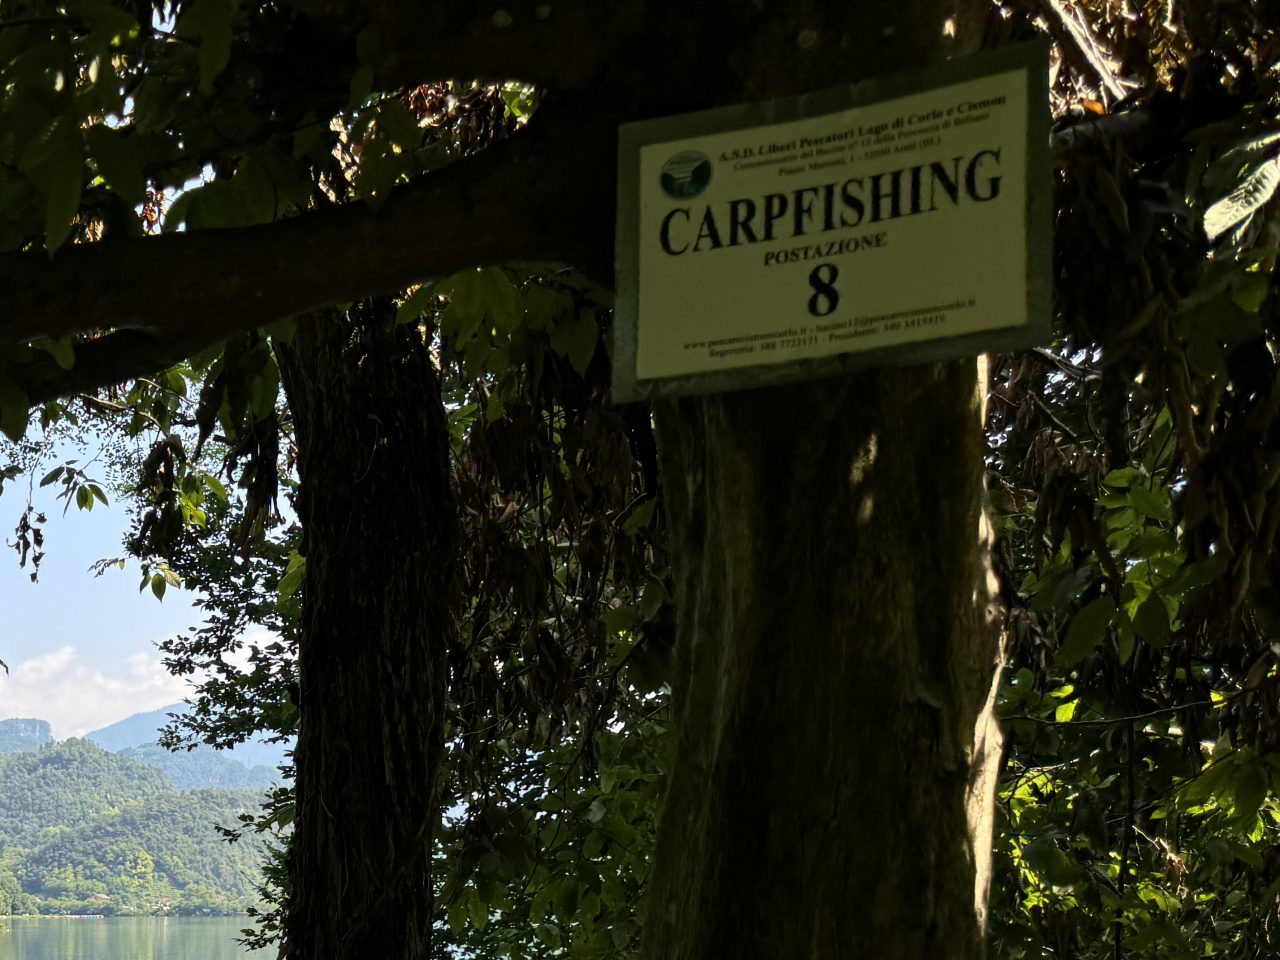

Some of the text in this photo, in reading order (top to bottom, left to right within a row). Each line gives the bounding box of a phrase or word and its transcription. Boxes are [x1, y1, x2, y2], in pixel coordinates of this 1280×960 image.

[720, 148, 754, 162] A.S.D.
[758, 141, 796, 155] Liberi
[800, 130, 853, 148] Pescatori
[892, 116, 904, 128] di
[946, 107, 954, 116] e
[957, 95, 1006, 113] Cismon
[659, 149, 1002, 256] CARPFISHING
[763, 232, 888, 267] POSTAZIONE
[807, 263, 839, 317] 8
